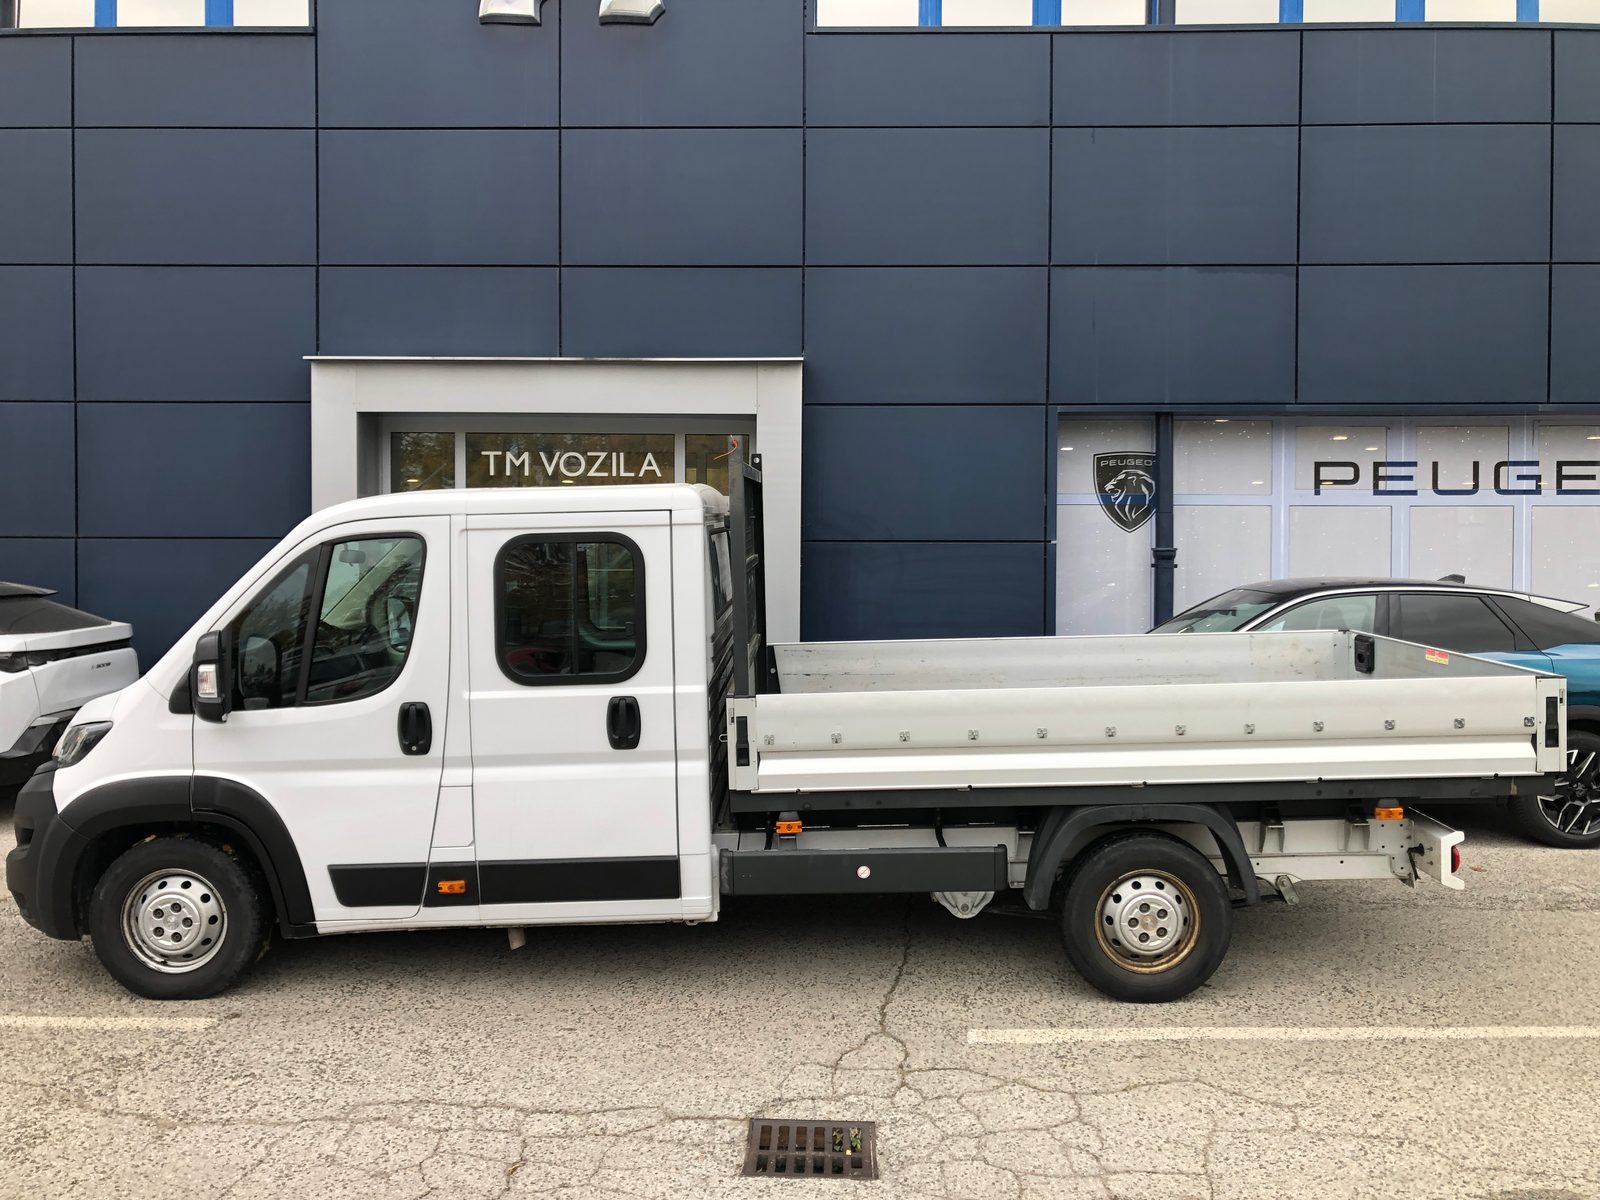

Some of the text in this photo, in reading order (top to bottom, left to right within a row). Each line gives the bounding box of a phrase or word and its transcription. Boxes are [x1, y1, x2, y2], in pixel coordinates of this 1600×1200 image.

[481, 451, 662, 477] TM VOZILA
[1314, 461, 1600, 495] PEUGE
